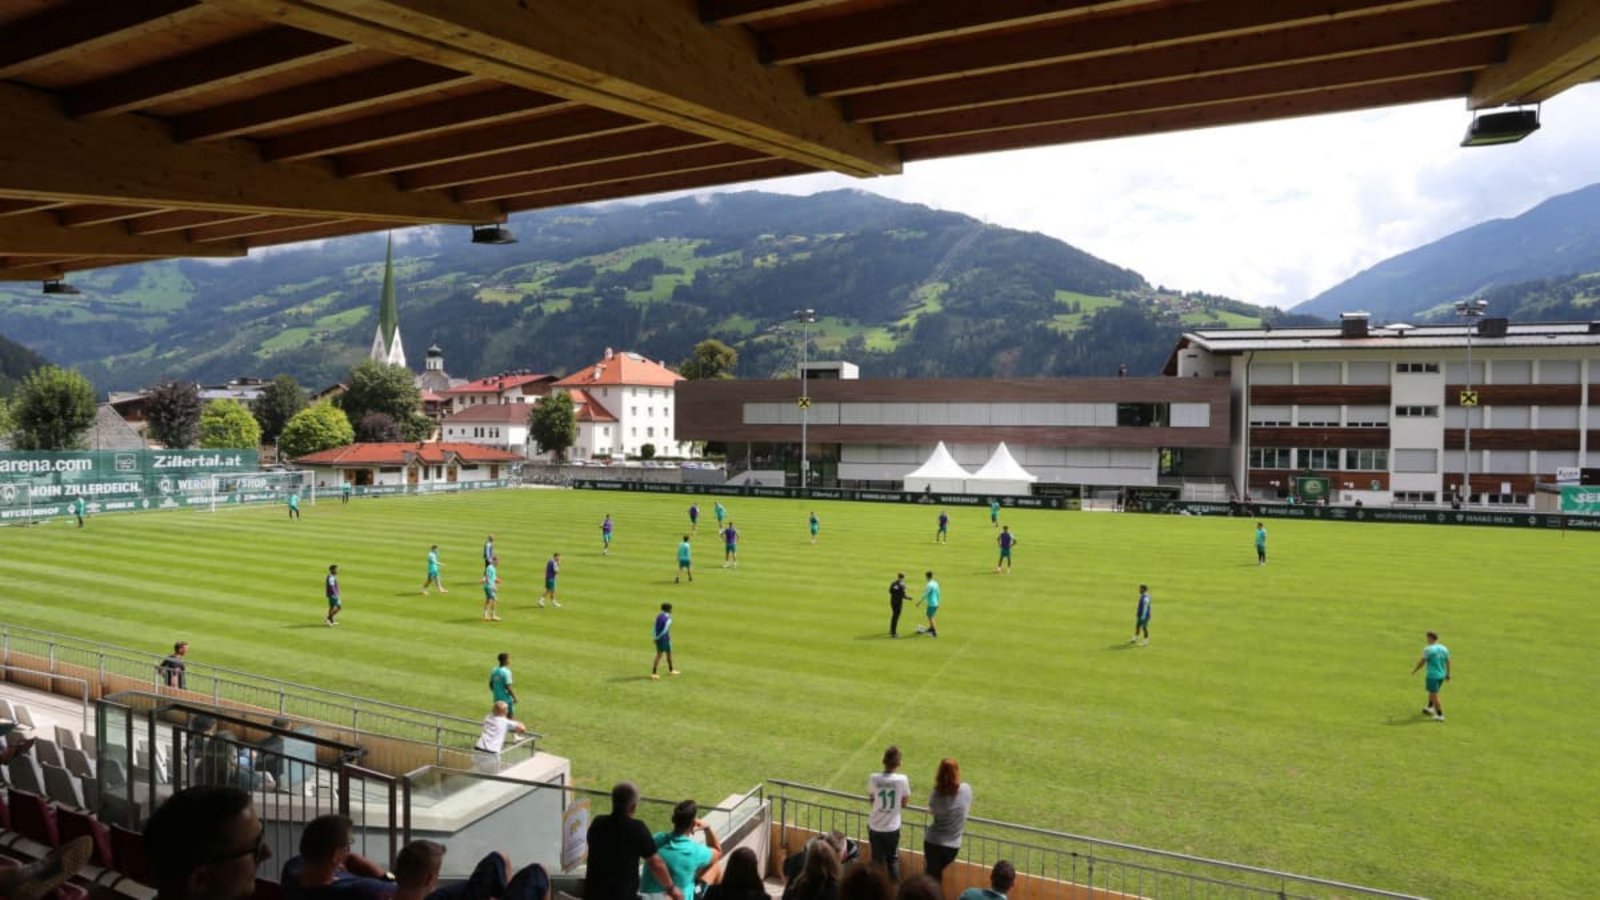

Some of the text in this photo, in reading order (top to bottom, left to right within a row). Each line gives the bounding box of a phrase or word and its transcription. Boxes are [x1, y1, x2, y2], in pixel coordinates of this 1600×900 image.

[0, 459, 92, 472] arena.com
[153, 454, 242, 468] Zillertal.at
[30, 485, 61, 497] MOIN
[878, 789, 896, 810] 11
